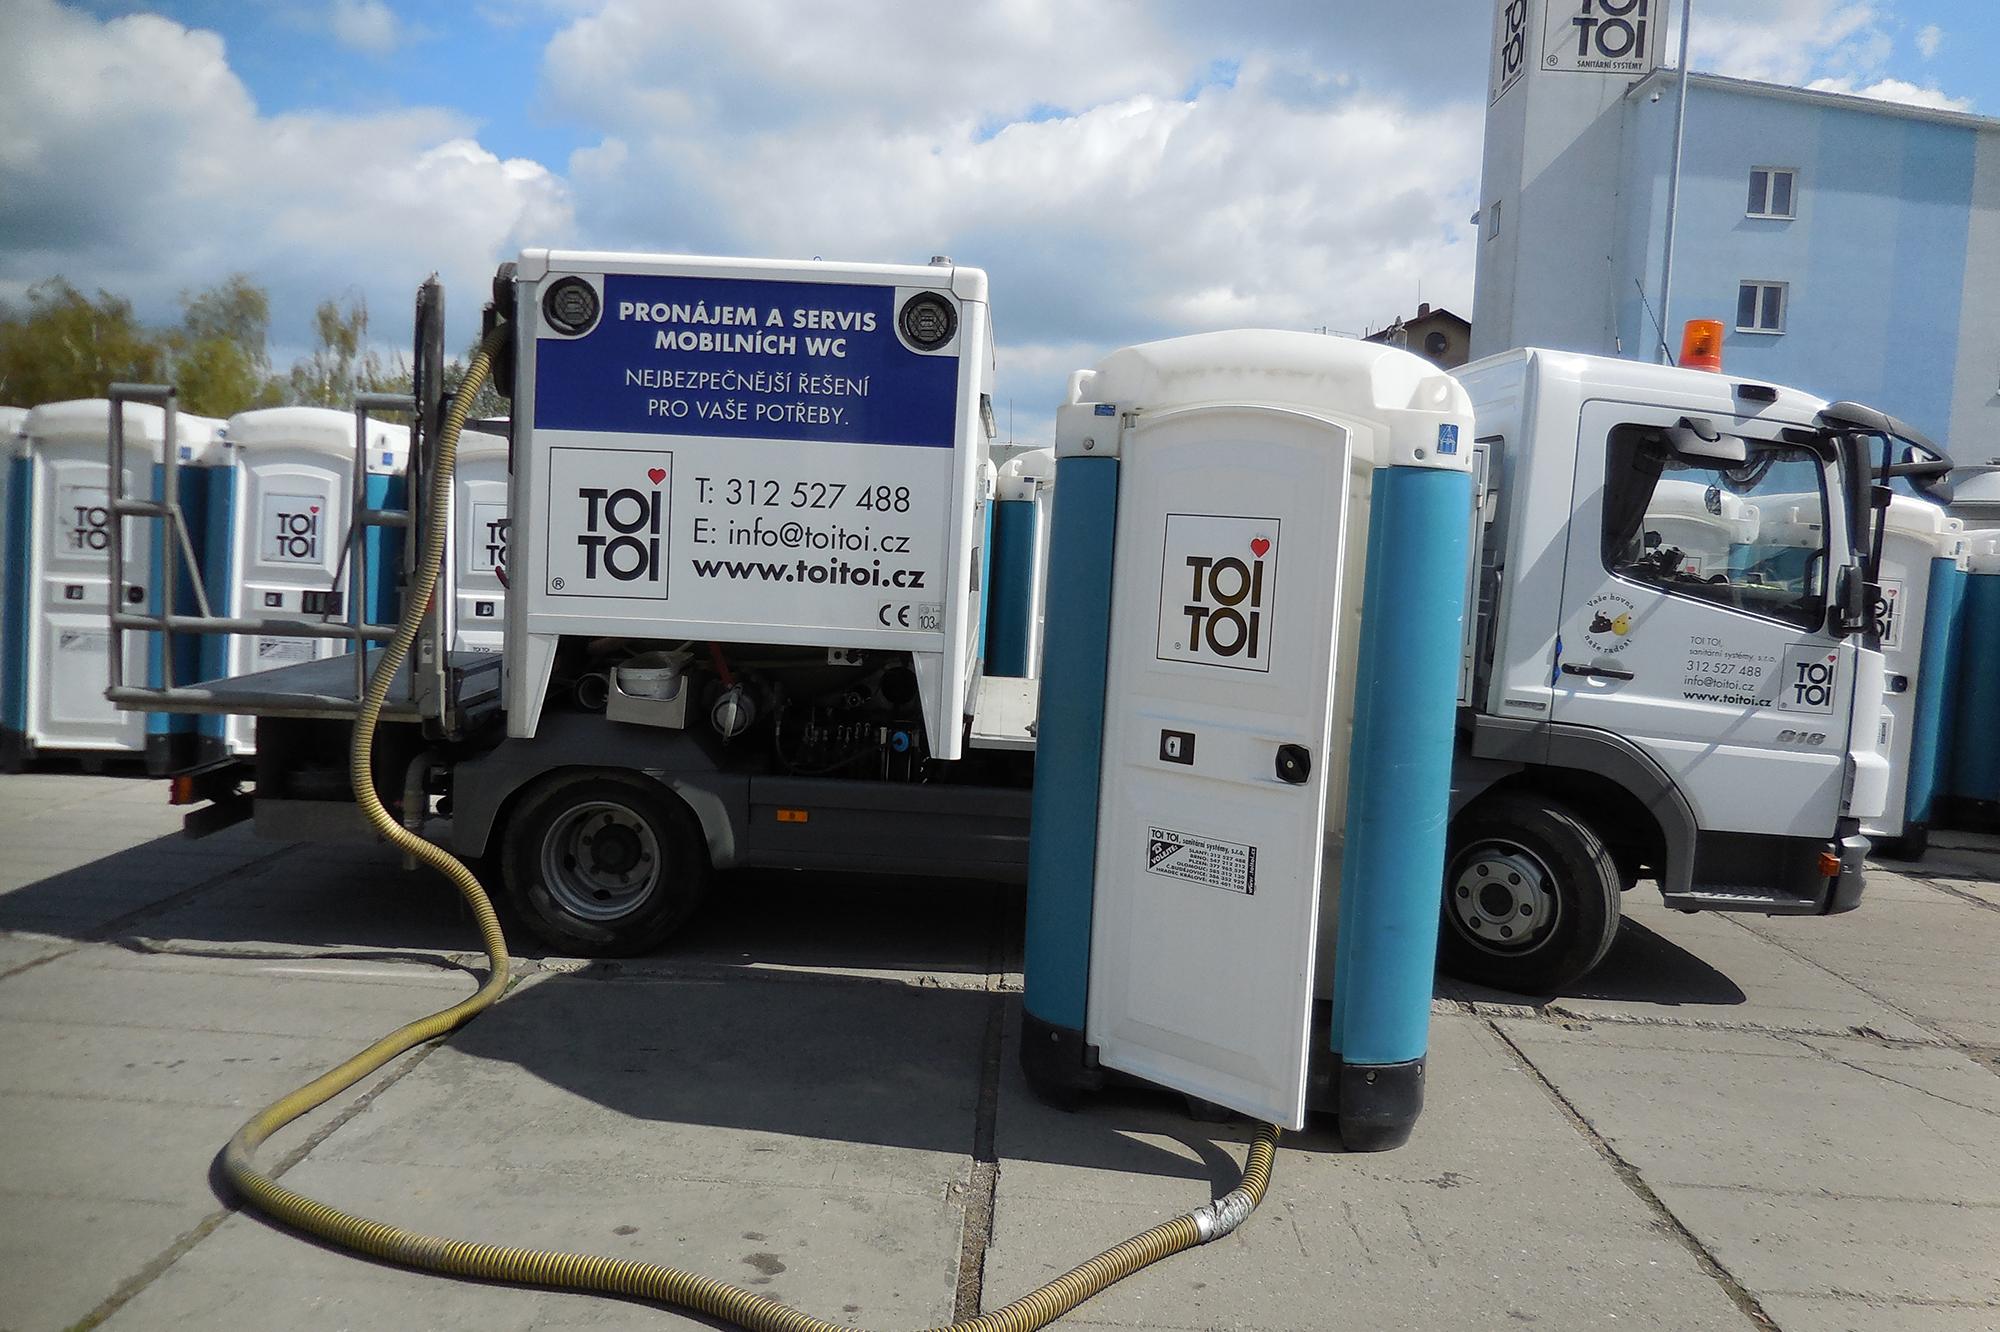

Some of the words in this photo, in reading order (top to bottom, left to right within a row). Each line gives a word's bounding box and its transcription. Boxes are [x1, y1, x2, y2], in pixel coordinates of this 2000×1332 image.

[1572, 17, 1646, 59] TOI
[1502, 26, 1525, 81] TOI
[1577, 60, 1612, 69] SANITÁRNÍ
[1613, 60, 1643, 70] SYSTÉMY
[619, 300, 758, 327] PRONÁJEM
[765, 309, 784, 327] A
[793, 310, 877, 332] SERVIS
[655, 329, 797, 356] MOBILNÍCH
[806, 337, 847, 358] WC
[626, 368, 792, 394] NEJBEZPEČNĚJŠÍ
[798, 373, 870, 397] ŘEŠENÍ
[648, 400, 690, 418] PRO
[696, 398, 748, 421] VAŠE
[756, 401, 849, 426] POTŘEBY.
[695, 477, 714, 505] T:
[726, 479, 780, 507] 312
[790, 482, 847, 510] 527
[856, 485, 911, 513] 488
[74, 506, 108, 527] TO
[579, 488, 661, 534] TOI
[278, 513, 317, 535] TOI
[694, 519, 716, 545] E:
[728, 518, 911, 553] info@toitoi.cz
[74, 528, 108, 549] TO
[276, 535, 315, 558] TOI
[578, 535, 660, 582] TOI
[692, 558, 925, 589] www.toitoi.cz
[1186, 556, 1263, 607] TOI
[1587, 595, 1607, 607] Vaše
[1610, 594, 1634, 610] hovna
[1874, 598, 1894, 618] OI
[1183, 606, 1260, 659] TOI
[1690, 636, 1705, 645] TOI
[1689, 649, 1722, 657] sanitární
[1686, 660, 1710, 672] 312
[1712, 663, 1735, 674] 527
[1739, 666, 1762, 677] 488
[1796, 662, 1833, 686] TOI
[1684, 675, 1755, 692] info@toitoi.cz
[1683, 692, 1772, 707] www.toitoi.cz
[1794, 684, 1831, 708] TOI
[1151, 829, 1164, 839] TOI
